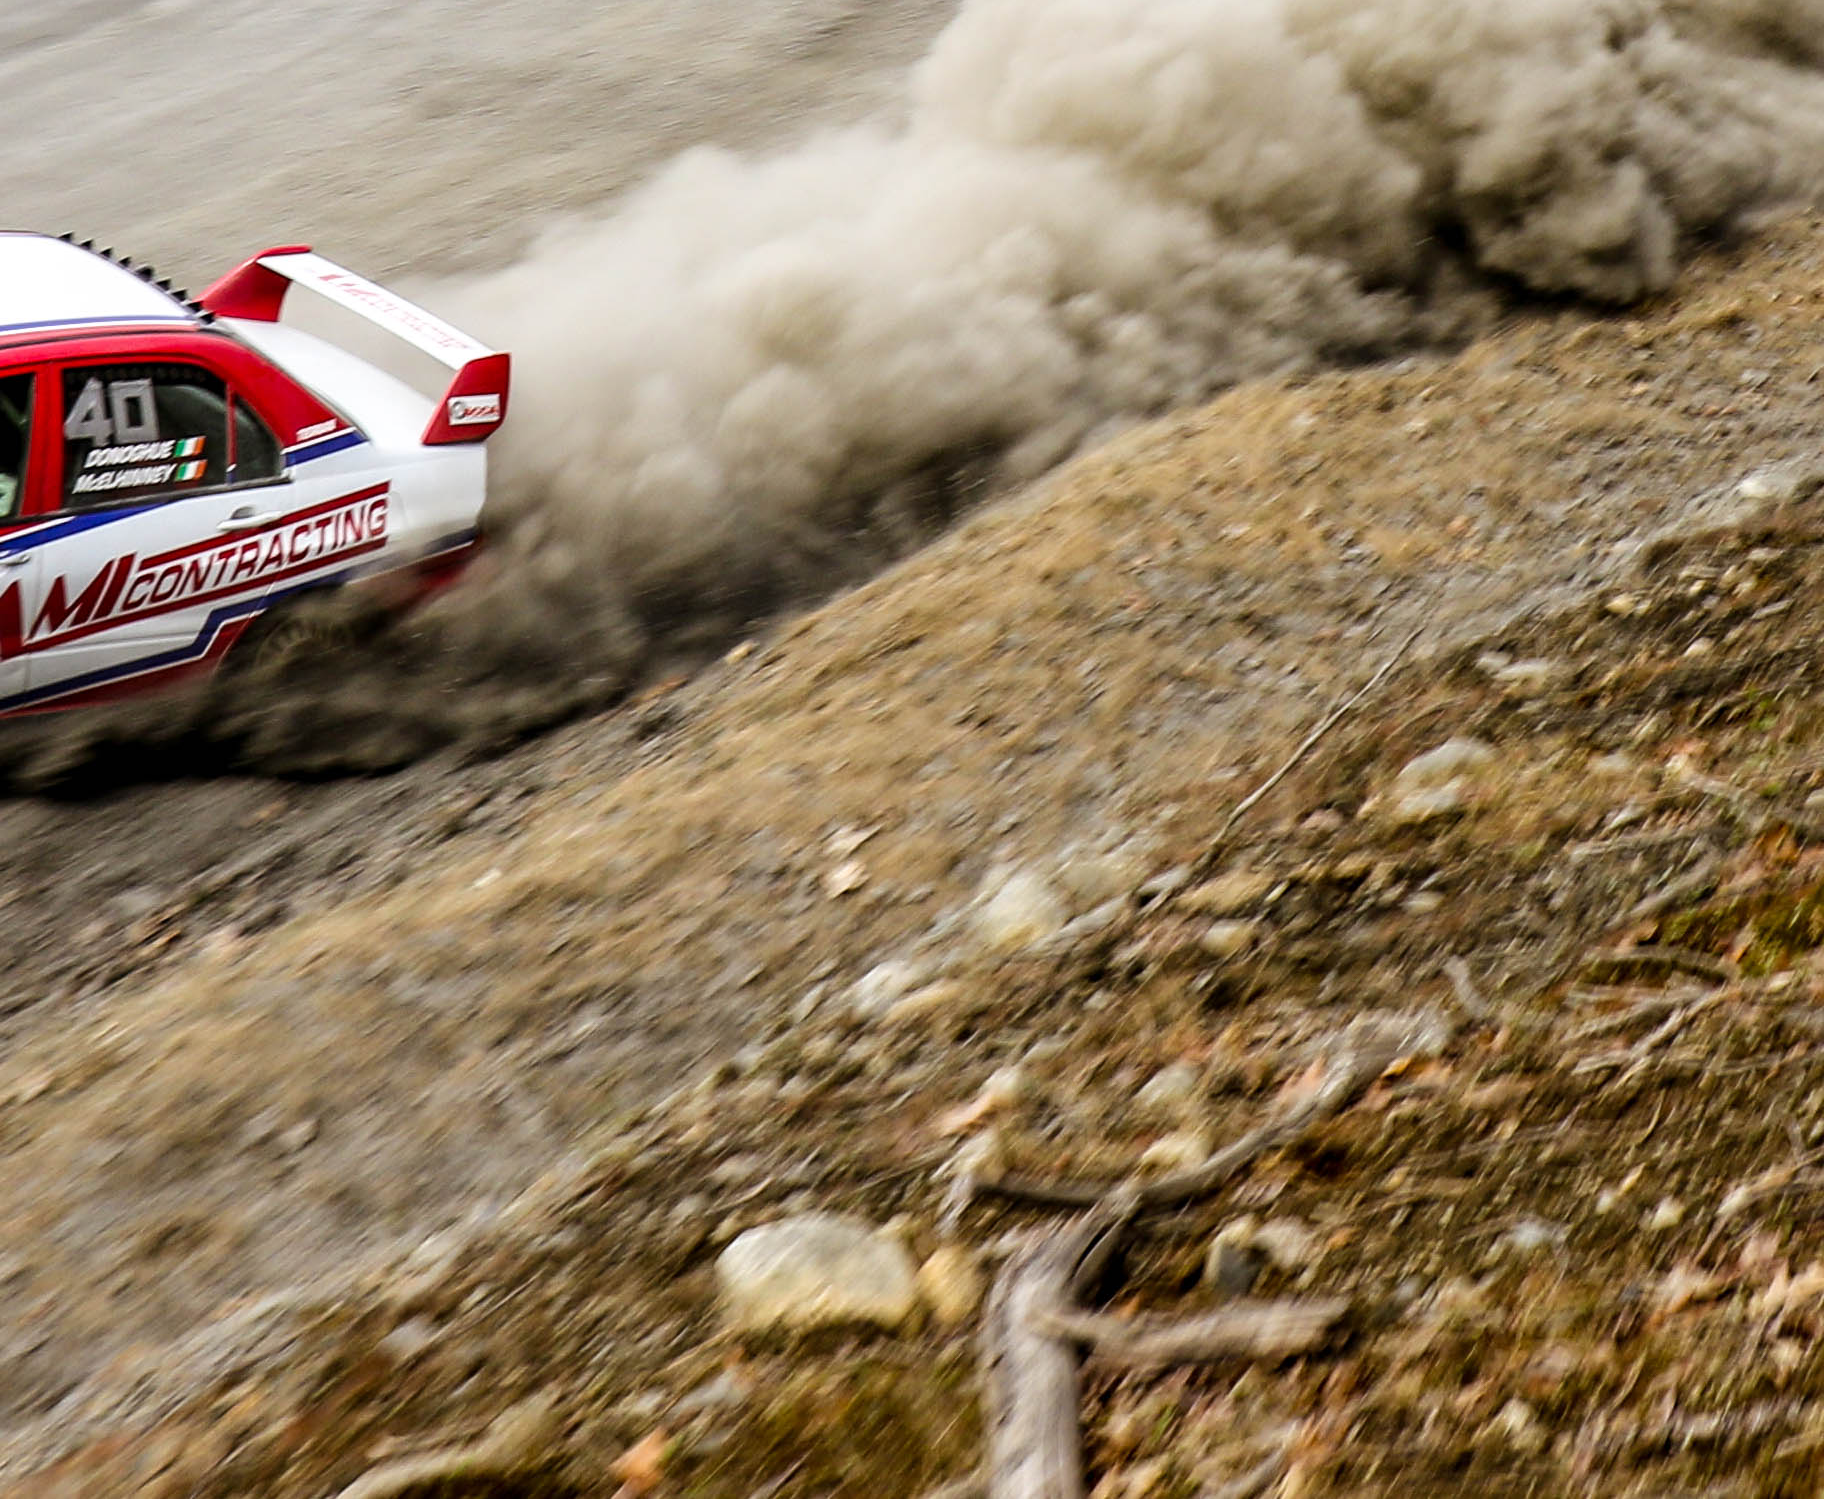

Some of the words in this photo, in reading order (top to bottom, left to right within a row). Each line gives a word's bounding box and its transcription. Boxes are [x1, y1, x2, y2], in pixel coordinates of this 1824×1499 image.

[64, 377, 160, 448] 40
[71, 463, 178, 495] McELHINNEY
[83, 439, 177, 469] DONOGHUE
[121, 498, 389, 611] CONTRACTING
